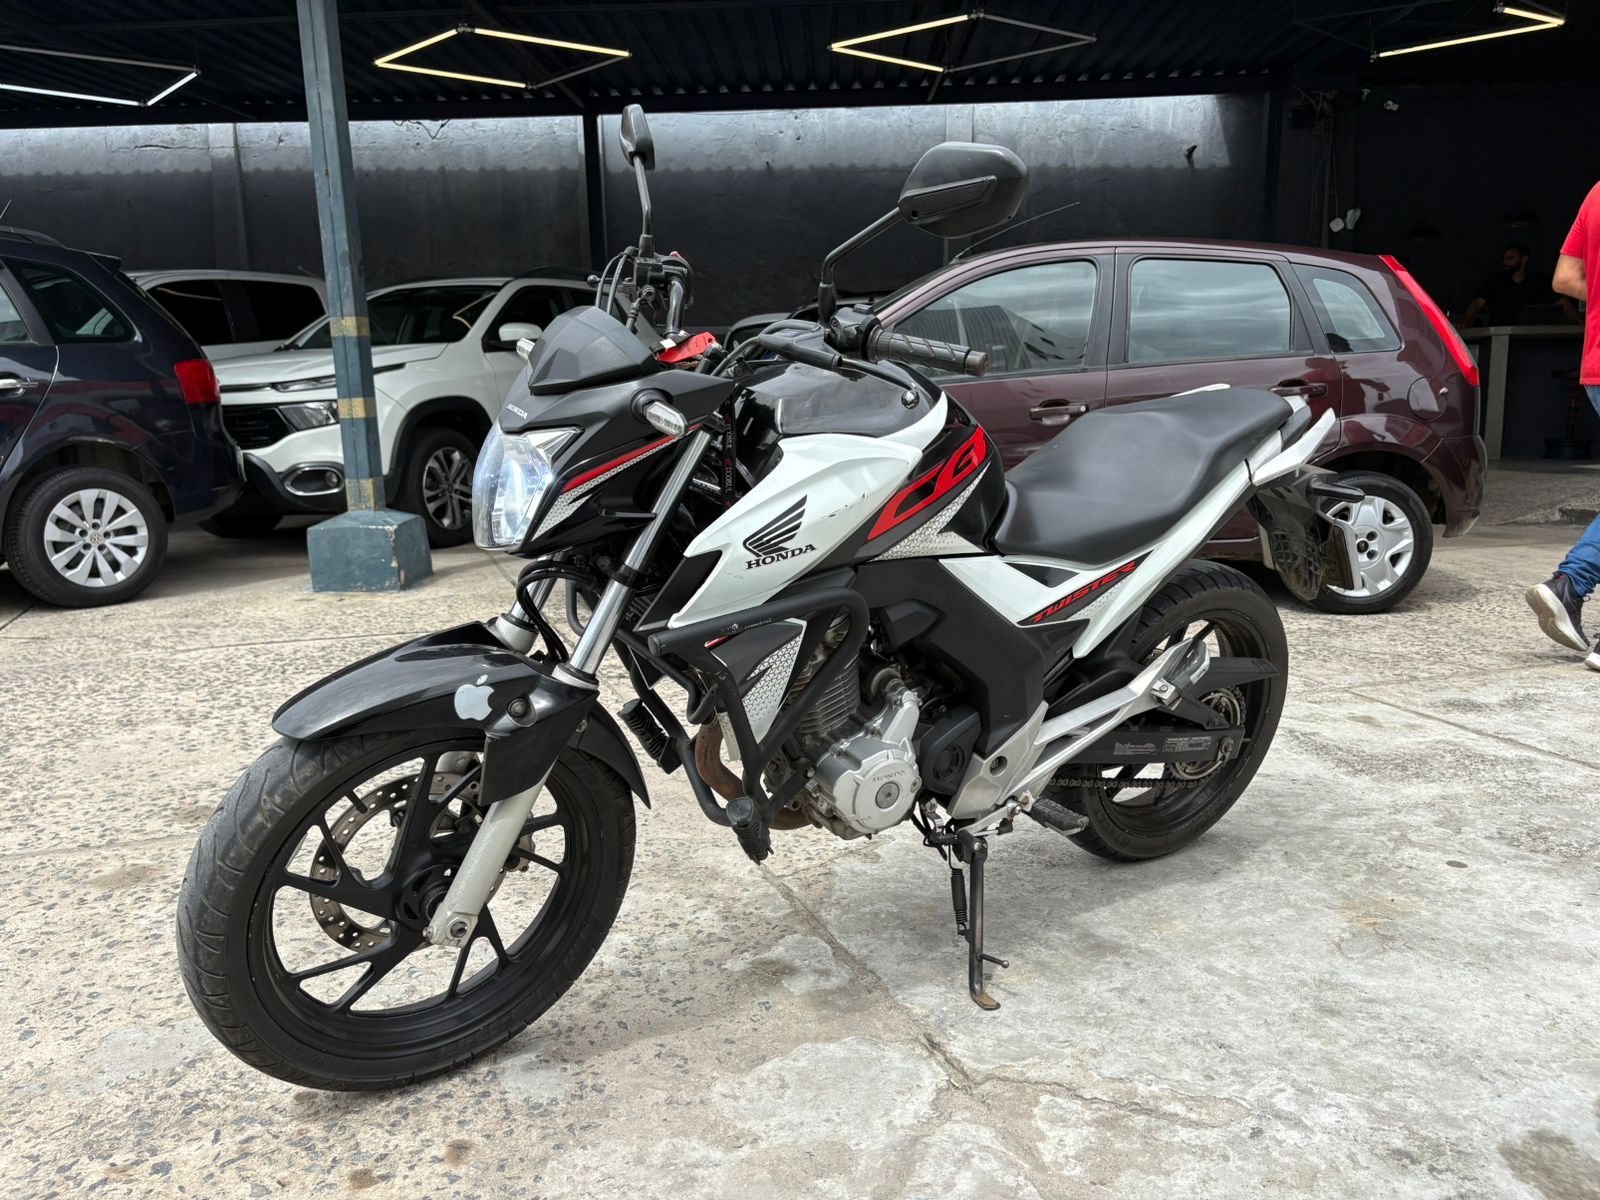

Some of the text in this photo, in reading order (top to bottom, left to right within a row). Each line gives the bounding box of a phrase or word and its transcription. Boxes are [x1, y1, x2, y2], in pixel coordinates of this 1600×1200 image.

[506, 403, 528, 419] HONDA
[868, 424, 988, 541] CB
[746, 543, 816, 570] HONDA
[1030, 560, 1137, 623] TWISTER
